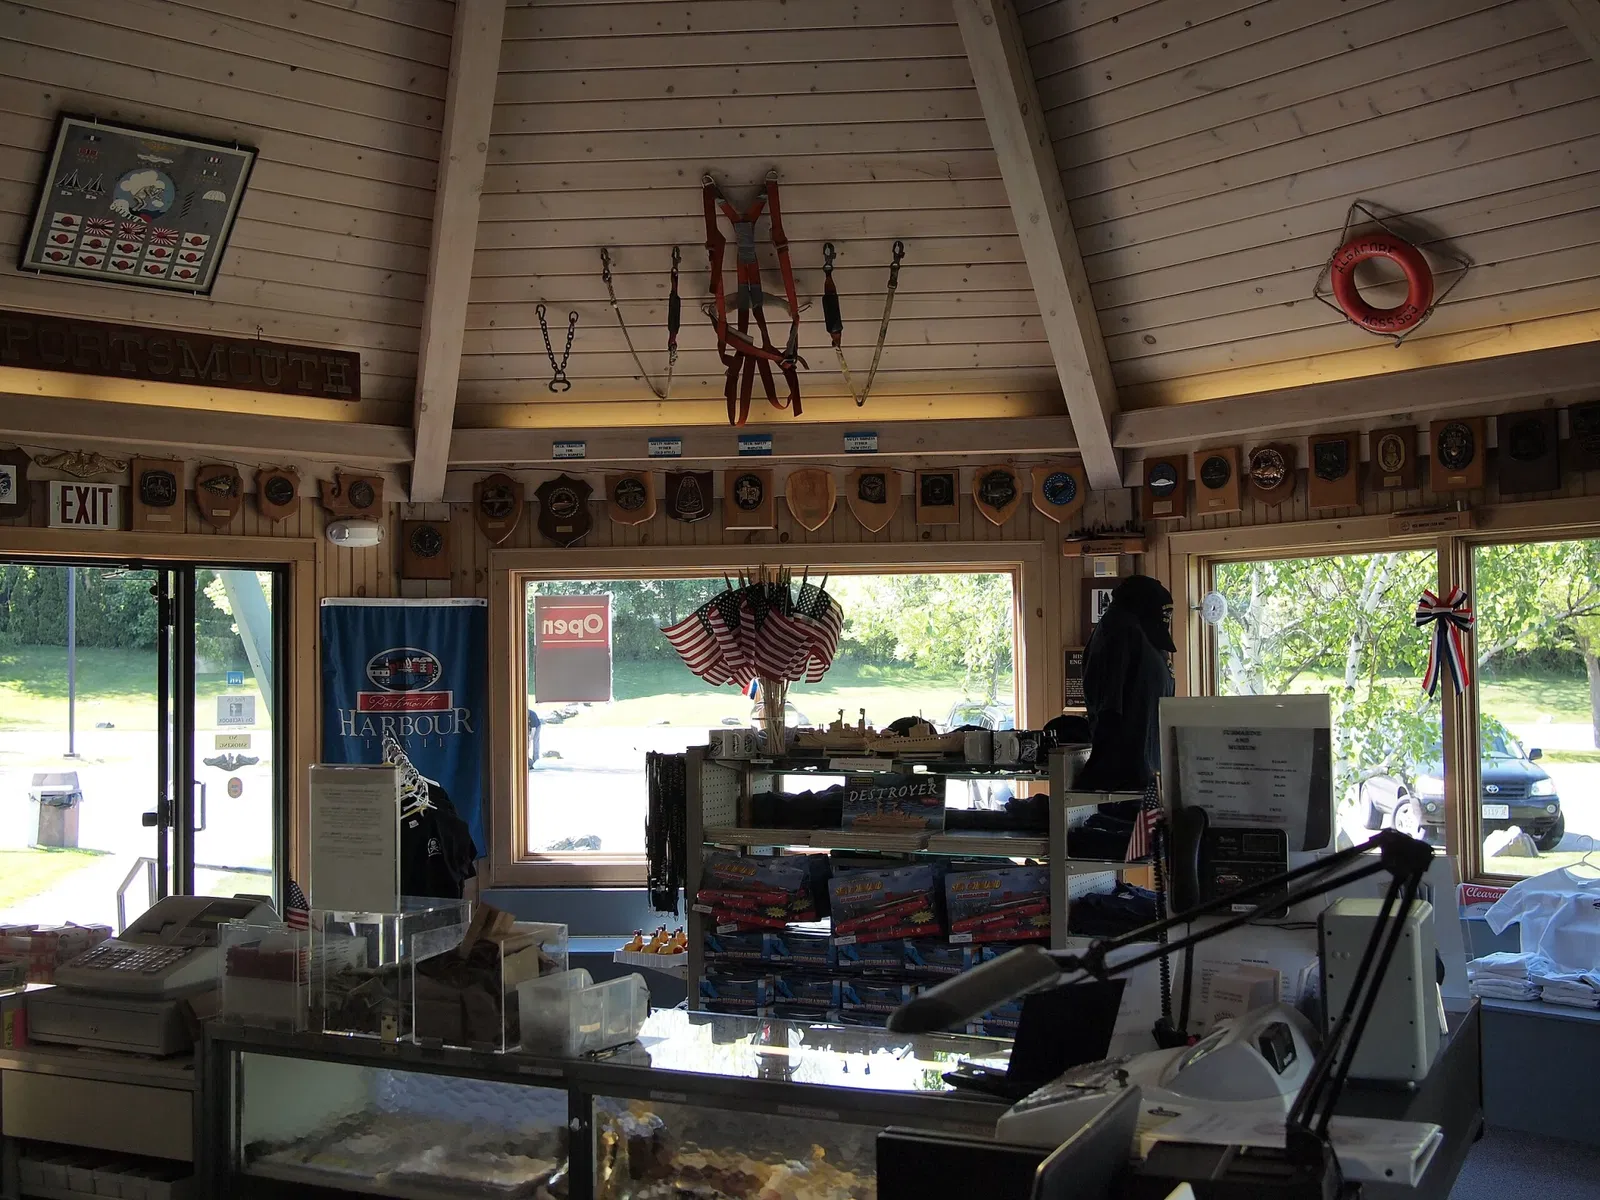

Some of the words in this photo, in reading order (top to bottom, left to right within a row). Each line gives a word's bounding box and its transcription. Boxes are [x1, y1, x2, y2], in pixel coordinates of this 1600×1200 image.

[1335, 242, 1398, 274] ALBACORE
[1362, 315, 1395, 328] AGSS
[1396, 304, 1418, 325] 569
[1, 320, 352, 394] PORTSMOUTH
[61, 486, 112, 525] EXIT
[369, 695, 440, 710] Portsmouth
[338, 708, 475, 736] HARBOUR
[850, 784, 938, 802] DESTROYER
